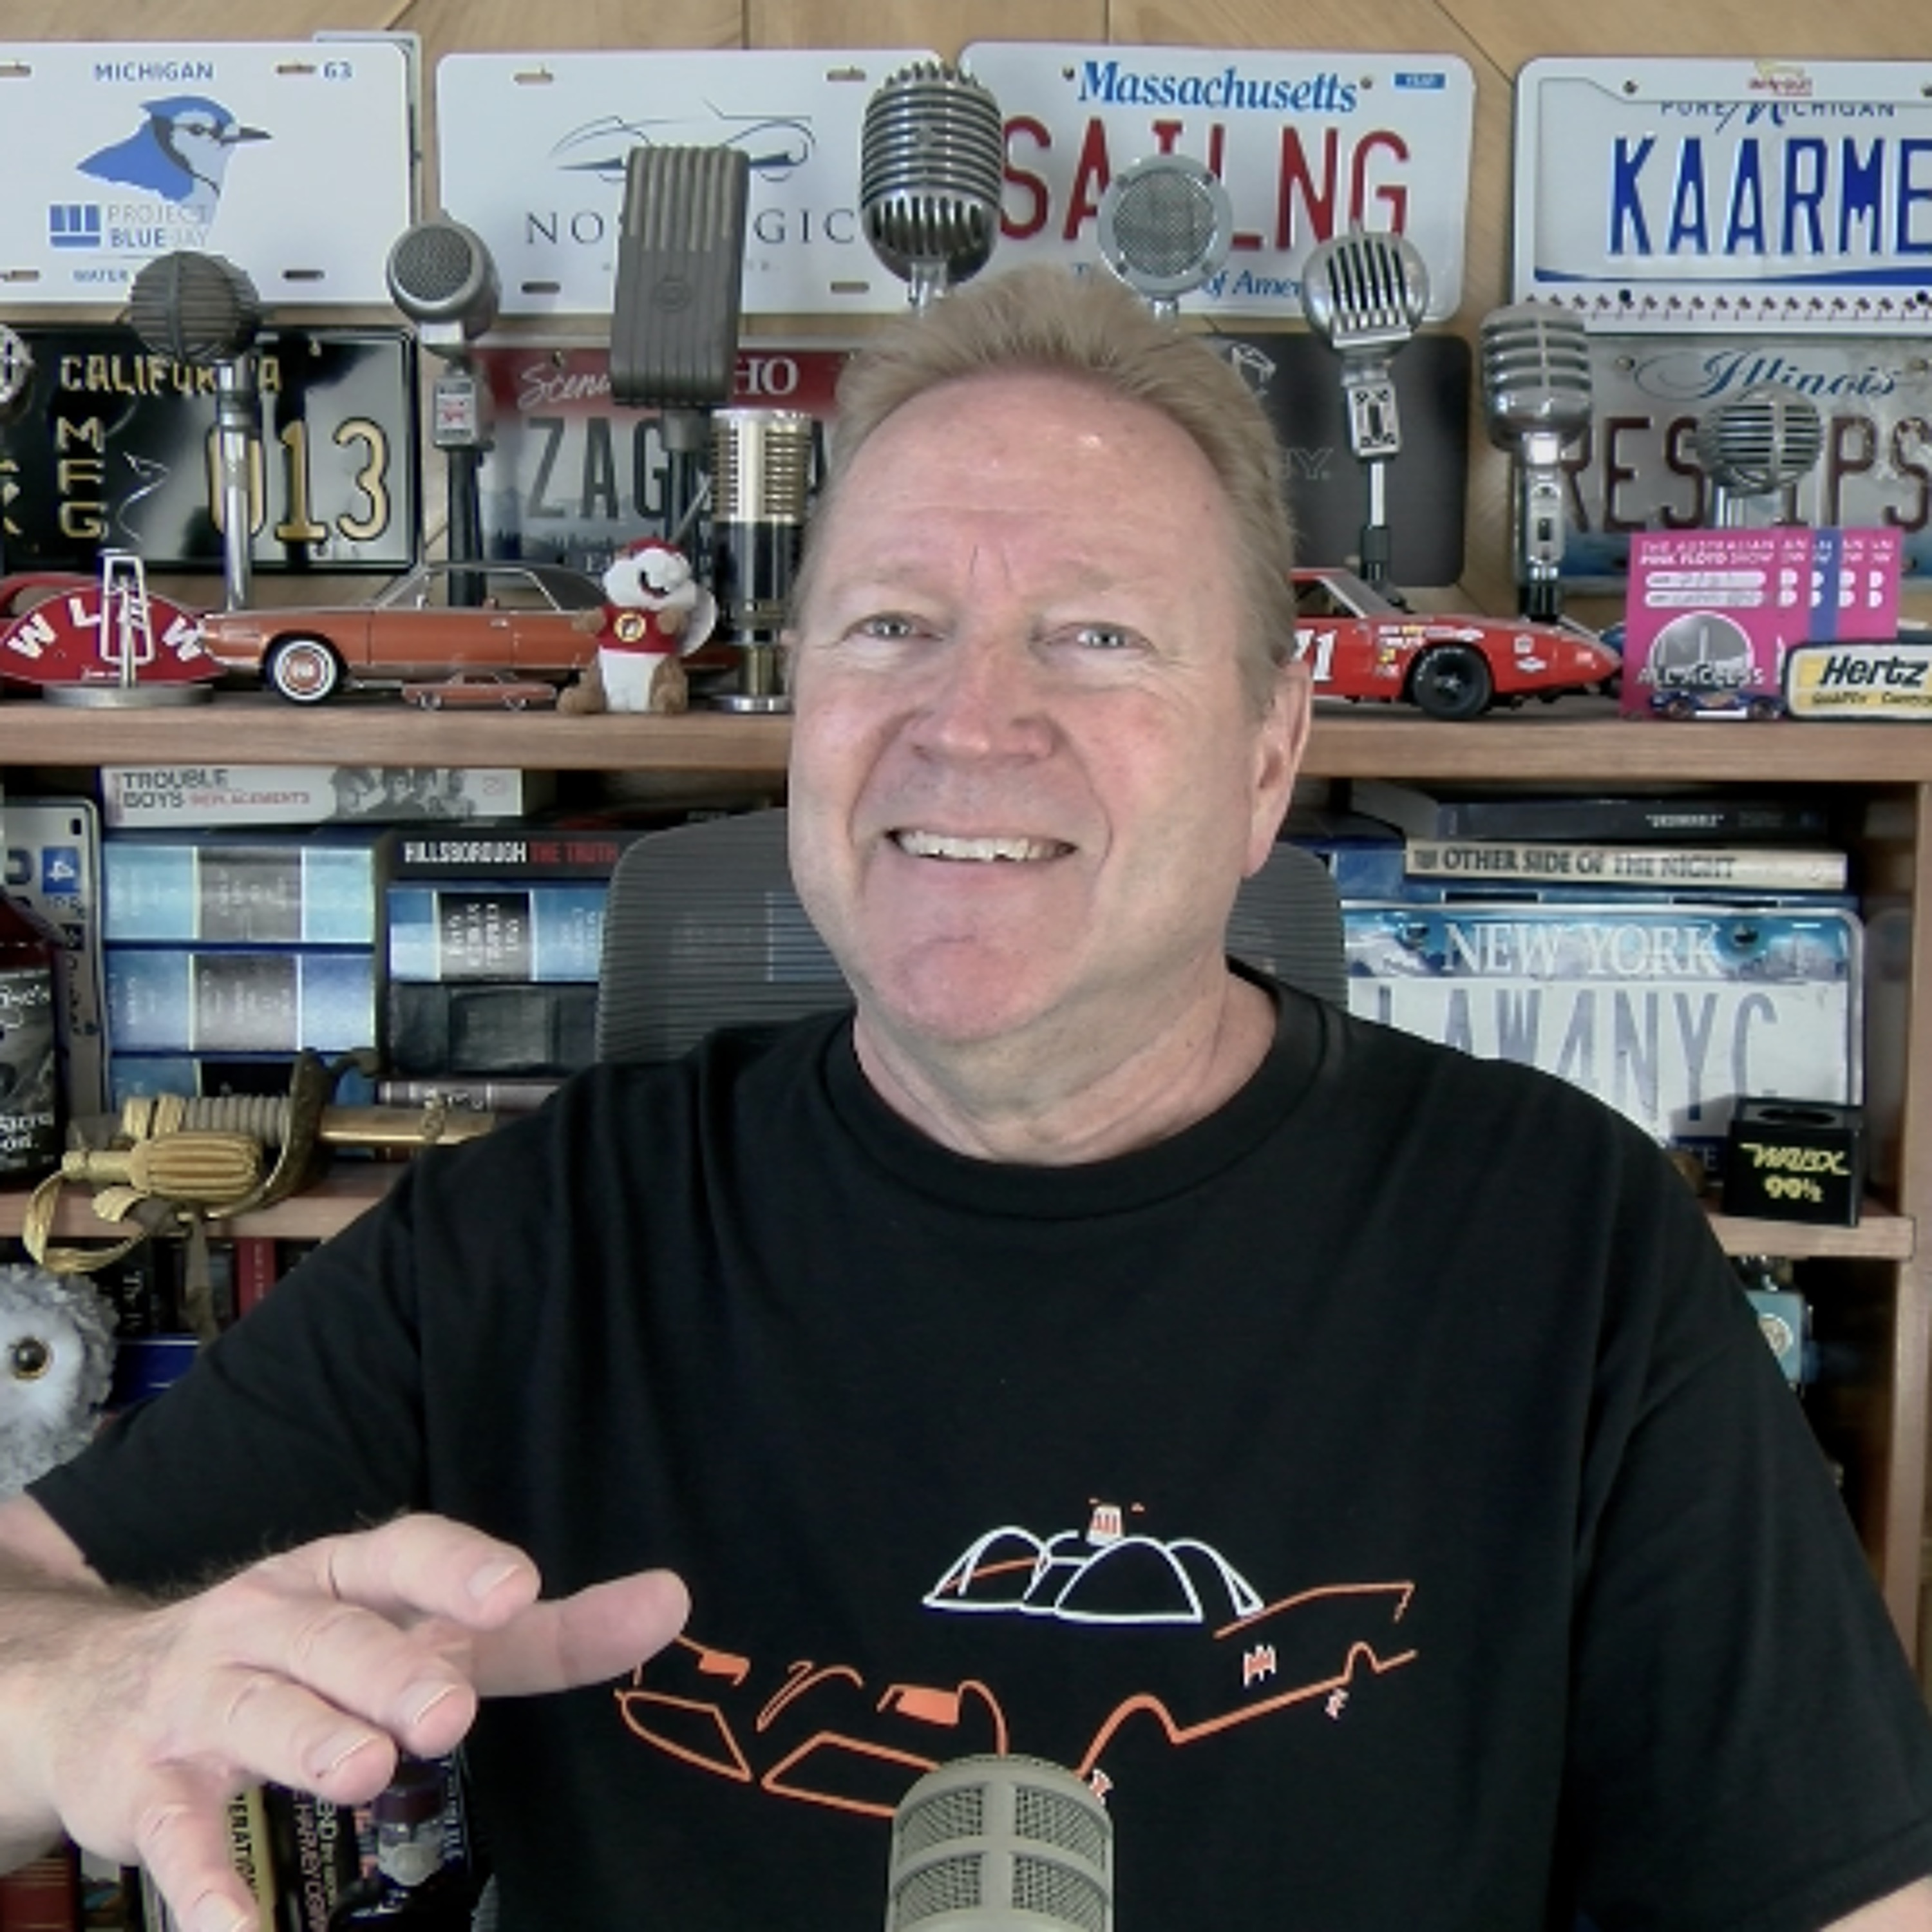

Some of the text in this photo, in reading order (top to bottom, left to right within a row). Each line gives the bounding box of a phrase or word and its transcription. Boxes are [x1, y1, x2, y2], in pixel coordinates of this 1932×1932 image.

[95, 62, 213, 80] MICHIGAN
[324, 62, 353, 79] 63
[1078, 61, 1358, 113] Massachusetts
[1608, 137, 1932, 256] KAARME
[106, 205, 209, 224] PROJECT
[524, 211, 857, 245] NOGIC
[110, 229, 166, 248] BLUE
[1232, 269, 1303, 298] Amer
[61, 355, 282, 395] CALIFORA
[1636, 345, 1903, 401] Illinois
[1560, 415, 1932, 533] RESPS
[1819, 654, 1929, 689] Hertz
[123, 769, 229, 789] TROUBLE
[123, 791, 185, 808] BOYS
[404, 841, 529, 864] HILLSBOROUGH
[1444, 848, 1520, 871] OTHER
[1522, 849, 1573, 874] SIDE
[1660, 857, 1738, 878] NIGHT
[48, 859, 76, 882] 4
[1445, 922, 1721, 976] NEW YORK
